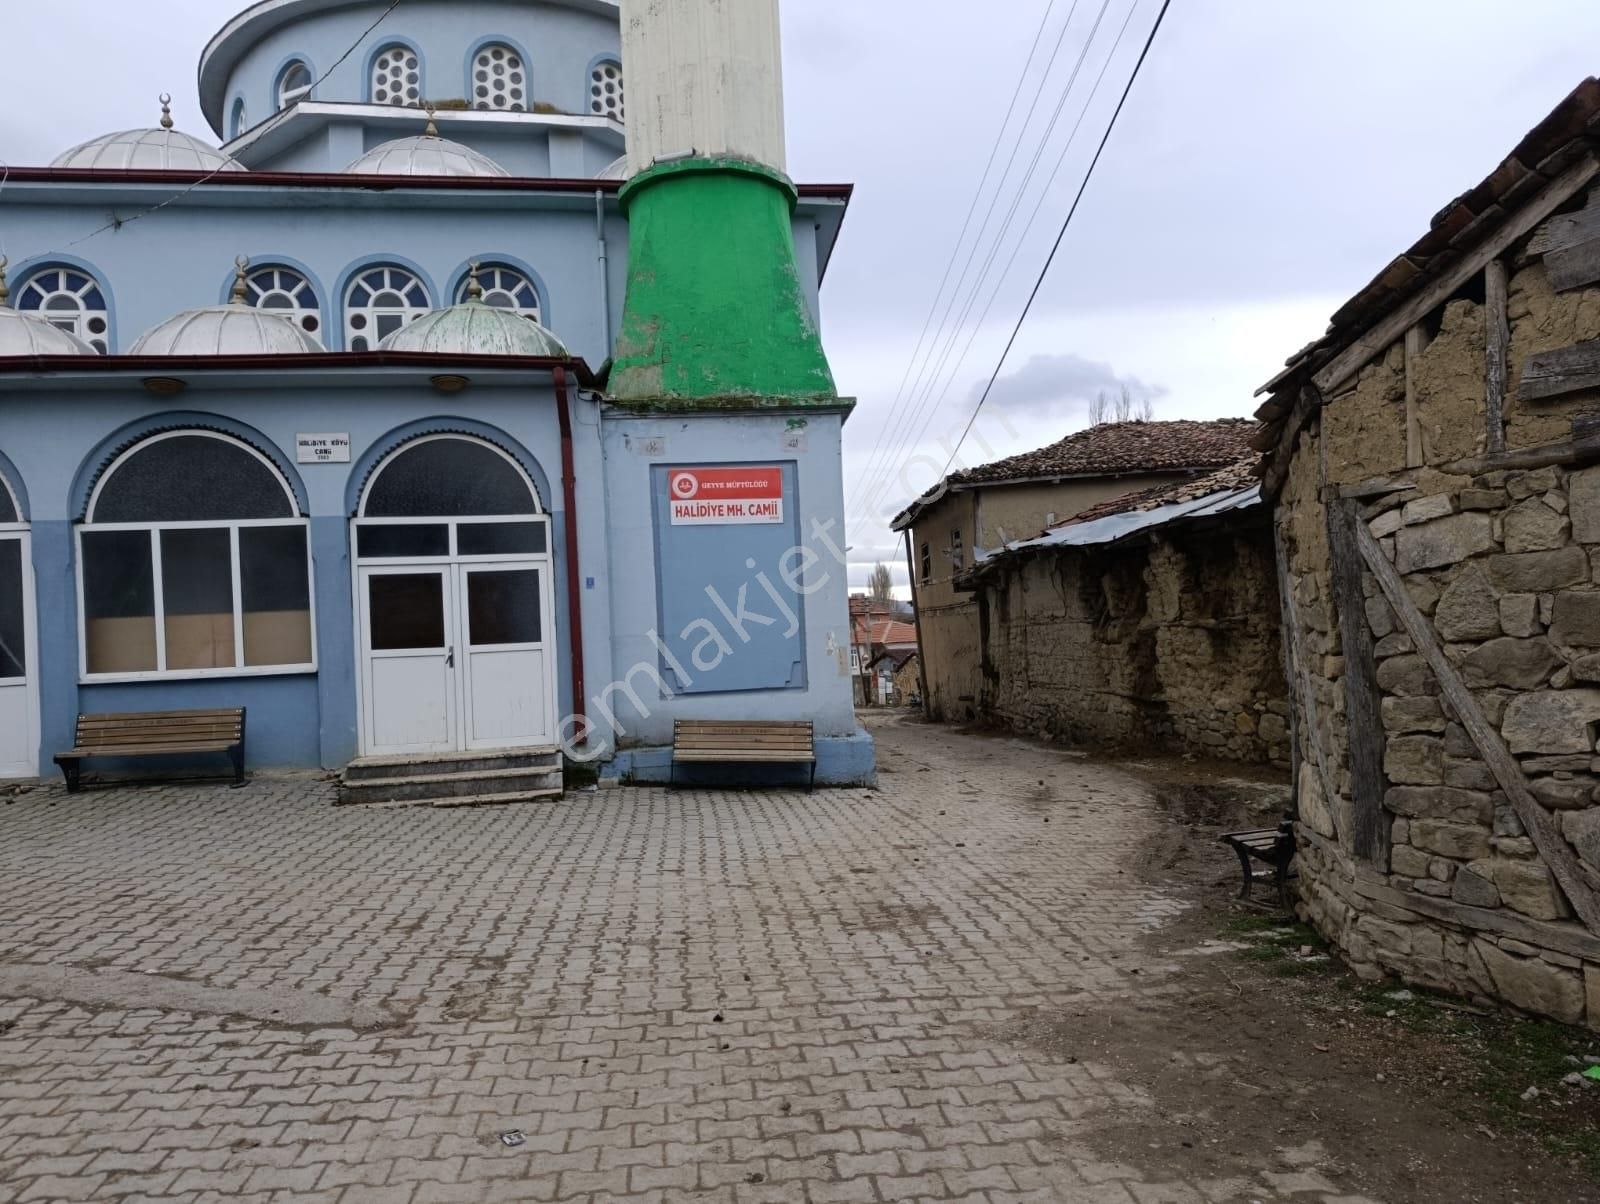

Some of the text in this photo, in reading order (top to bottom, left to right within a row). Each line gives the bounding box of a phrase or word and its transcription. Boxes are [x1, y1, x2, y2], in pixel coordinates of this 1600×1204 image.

[675, 501, 778, 518] HALİDİYE MH. CAMİİ
